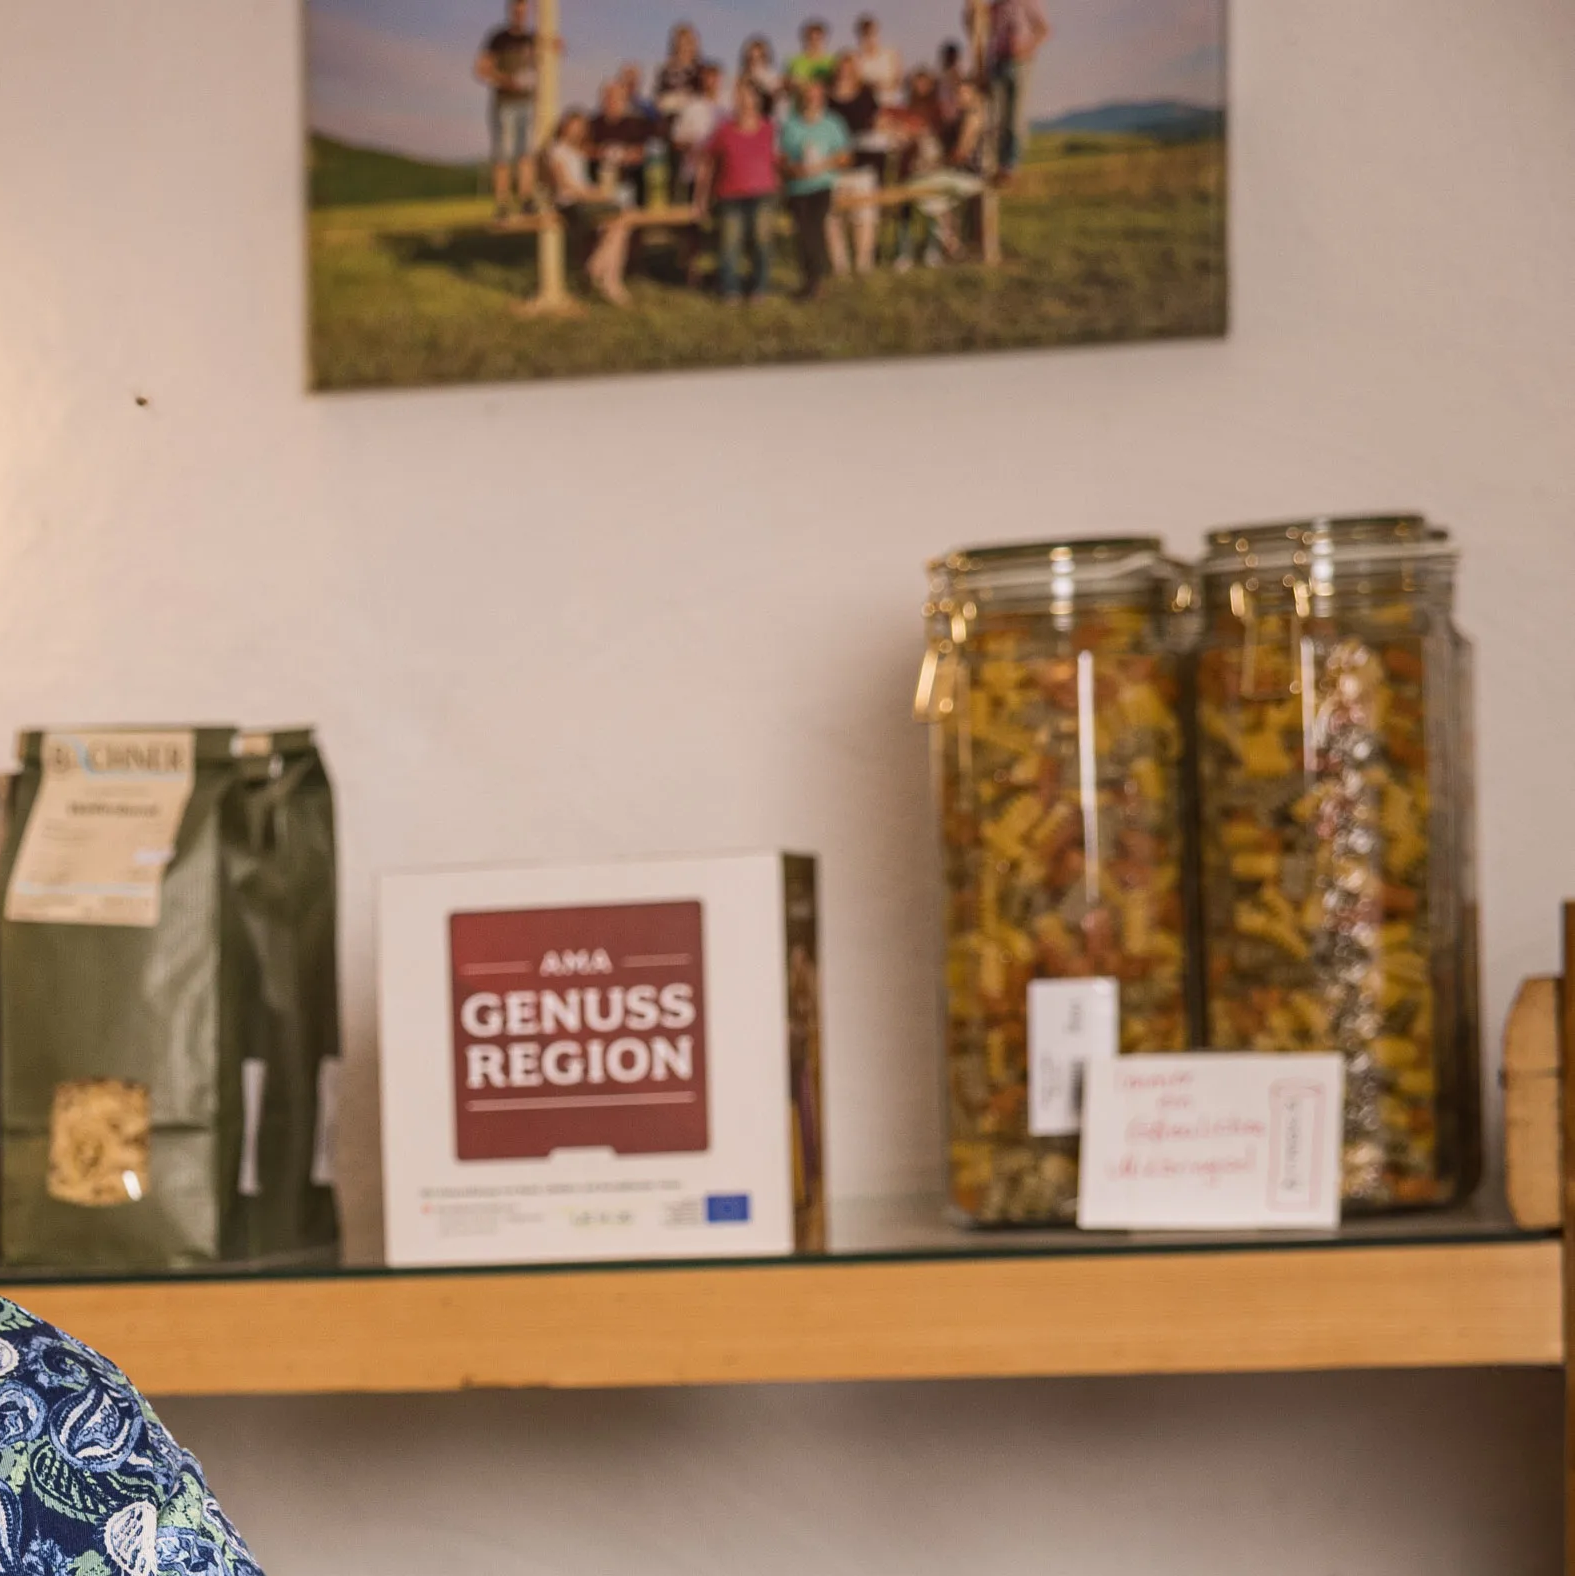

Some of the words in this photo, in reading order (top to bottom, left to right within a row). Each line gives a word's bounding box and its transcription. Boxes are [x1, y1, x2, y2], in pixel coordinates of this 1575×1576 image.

[538, 948, 614, 978] AMA
[459, 982, 697, 1039] GENUSS
[465, 1035, 695, 1090] REGION
